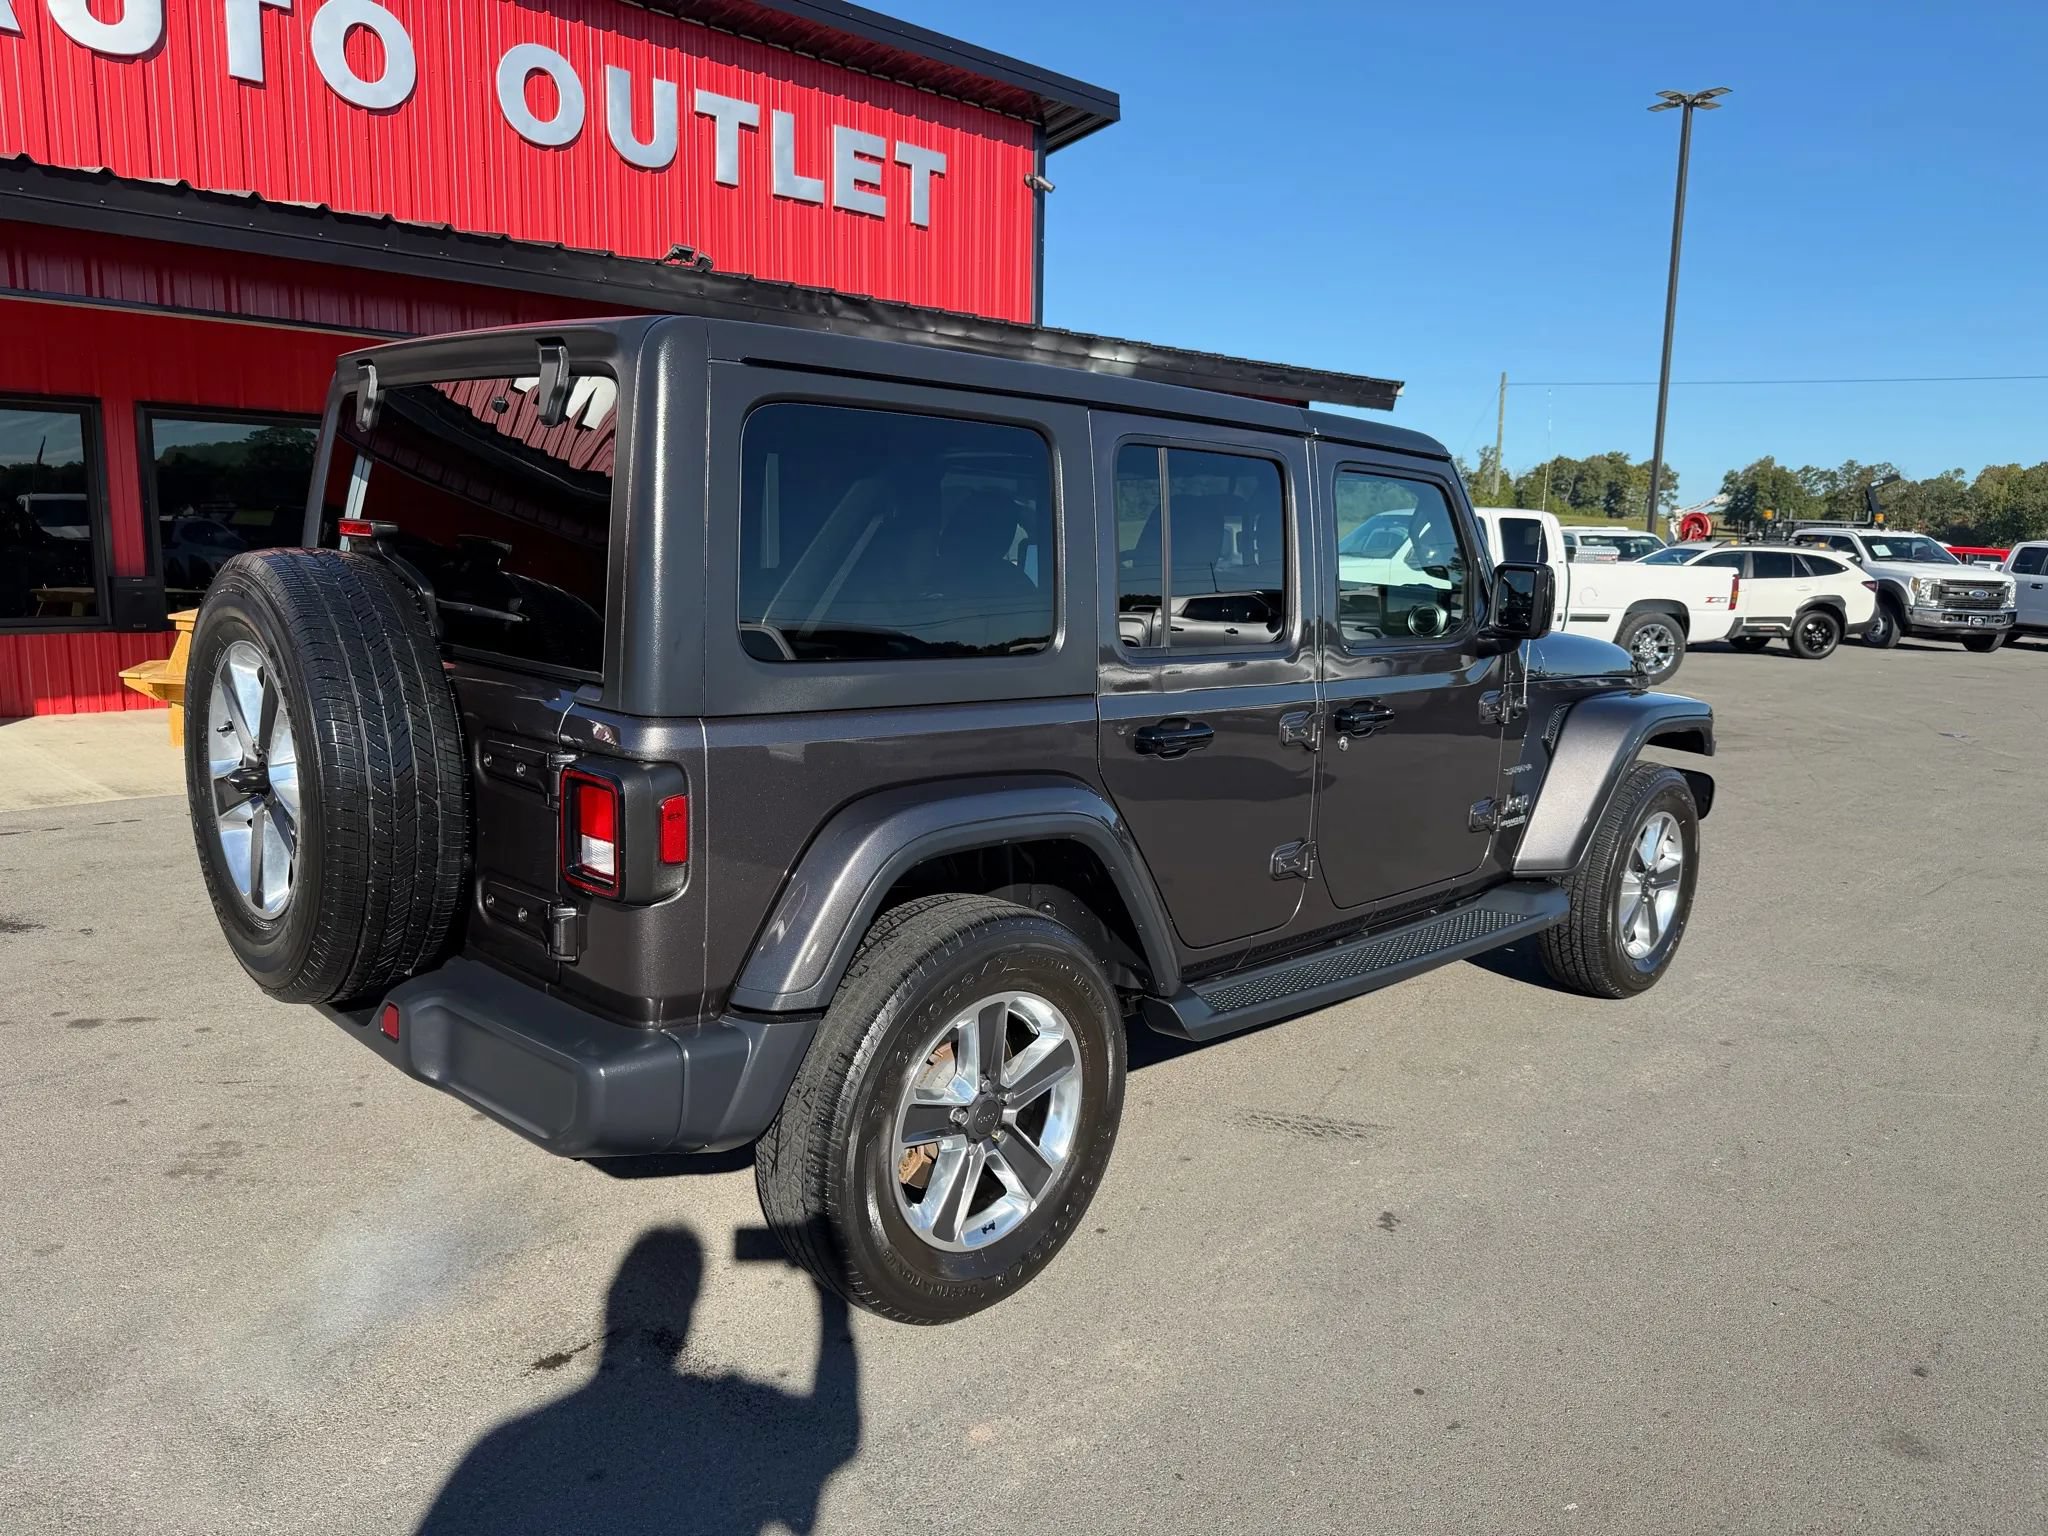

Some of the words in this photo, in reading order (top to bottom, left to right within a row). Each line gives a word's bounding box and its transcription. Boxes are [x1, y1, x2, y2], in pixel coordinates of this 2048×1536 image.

[0, 0, 417, 109] UTO
[497, 42, 947, 228] OUTLET
[1502, 793, 1529, 815] Jeep
